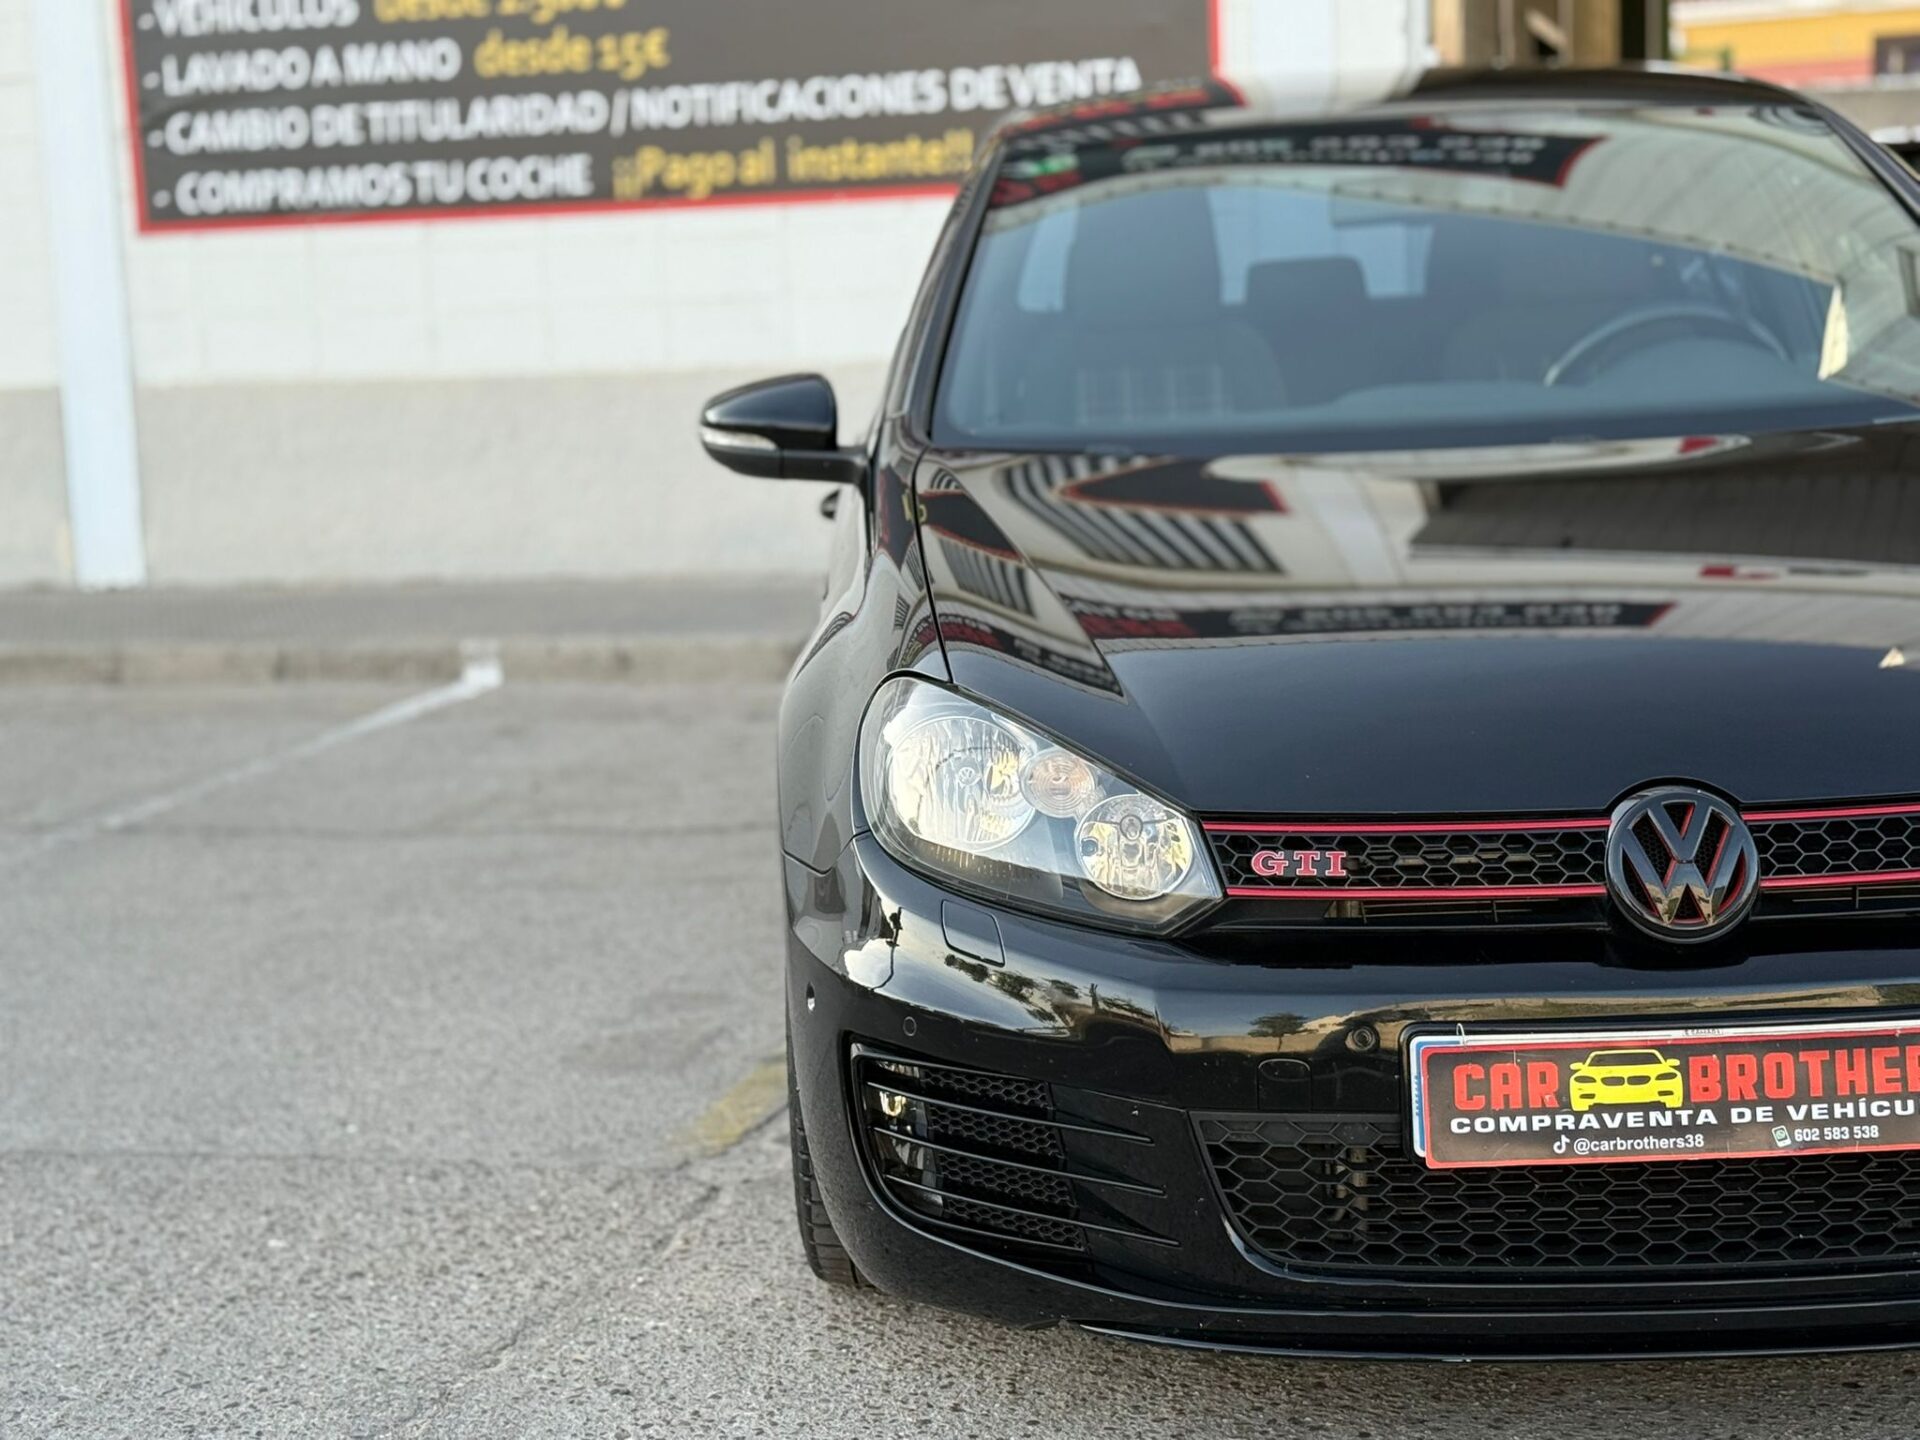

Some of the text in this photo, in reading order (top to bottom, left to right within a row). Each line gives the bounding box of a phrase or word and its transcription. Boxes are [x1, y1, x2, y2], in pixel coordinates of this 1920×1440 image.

[161, 24, 671, 97] LAVADO A MANO desde 15€
[164, 106, 310, 154] CAMBIO
[312, 104, 364, 147] DE
[364, 90, 609, 143] TITULARIDAD
[631, 68, 947, 129] NOTIFICACIONES
[949, 64, 999, 110] DE
[999, 56, 1143, 105] VENTA
[175, 165, 413, 216] COMPRAMOS
[413, 160, 465, 203] TU
[466, 153, 594, 201] COCHE
[738, 135, 776, 187] al
[1250, 849, 1347, 877] GTI
[1611, 792, 1752, 935] VW
[1450, 1097, 1915, 1134] COMPRAVENTA DE VEHÍCU
[1453, 1061, 1560, 1111] CAR
[1573, 1124, 1879, 1155] @carbrothers38 602 583 538
